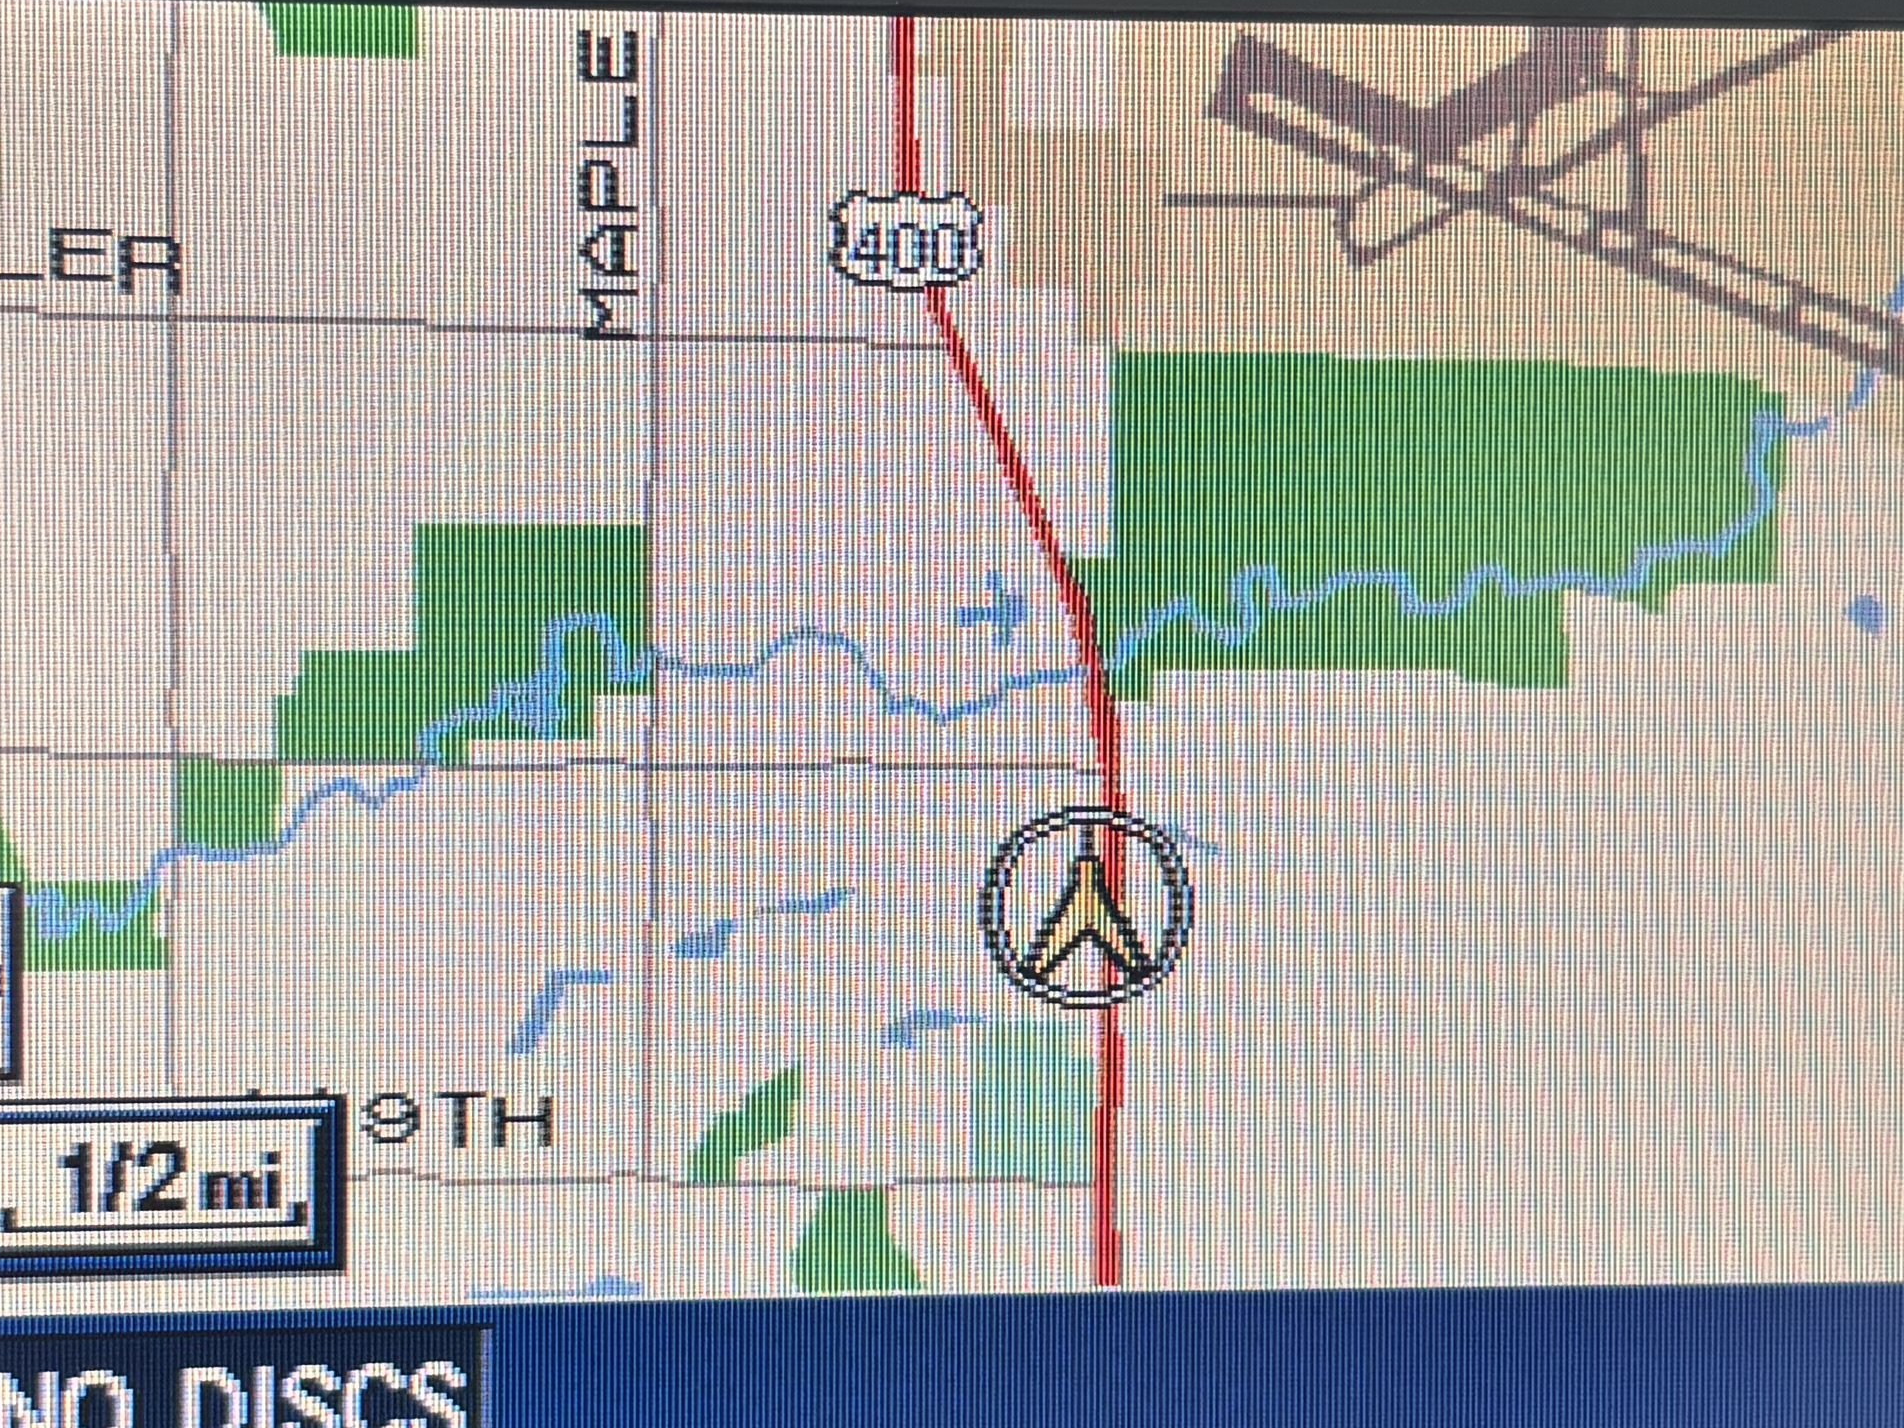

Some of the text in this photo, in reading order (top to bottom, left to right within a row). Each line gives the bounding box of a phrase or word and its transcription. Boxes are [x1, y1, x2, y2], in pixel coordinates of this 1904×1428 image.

[578, 28, 639, 340] MAPLE
[850, 222, 966, 274] 400
[246, 1088, 552, 1148] 9TH
[58, 1140, 282, 1213] 1/2 mi
